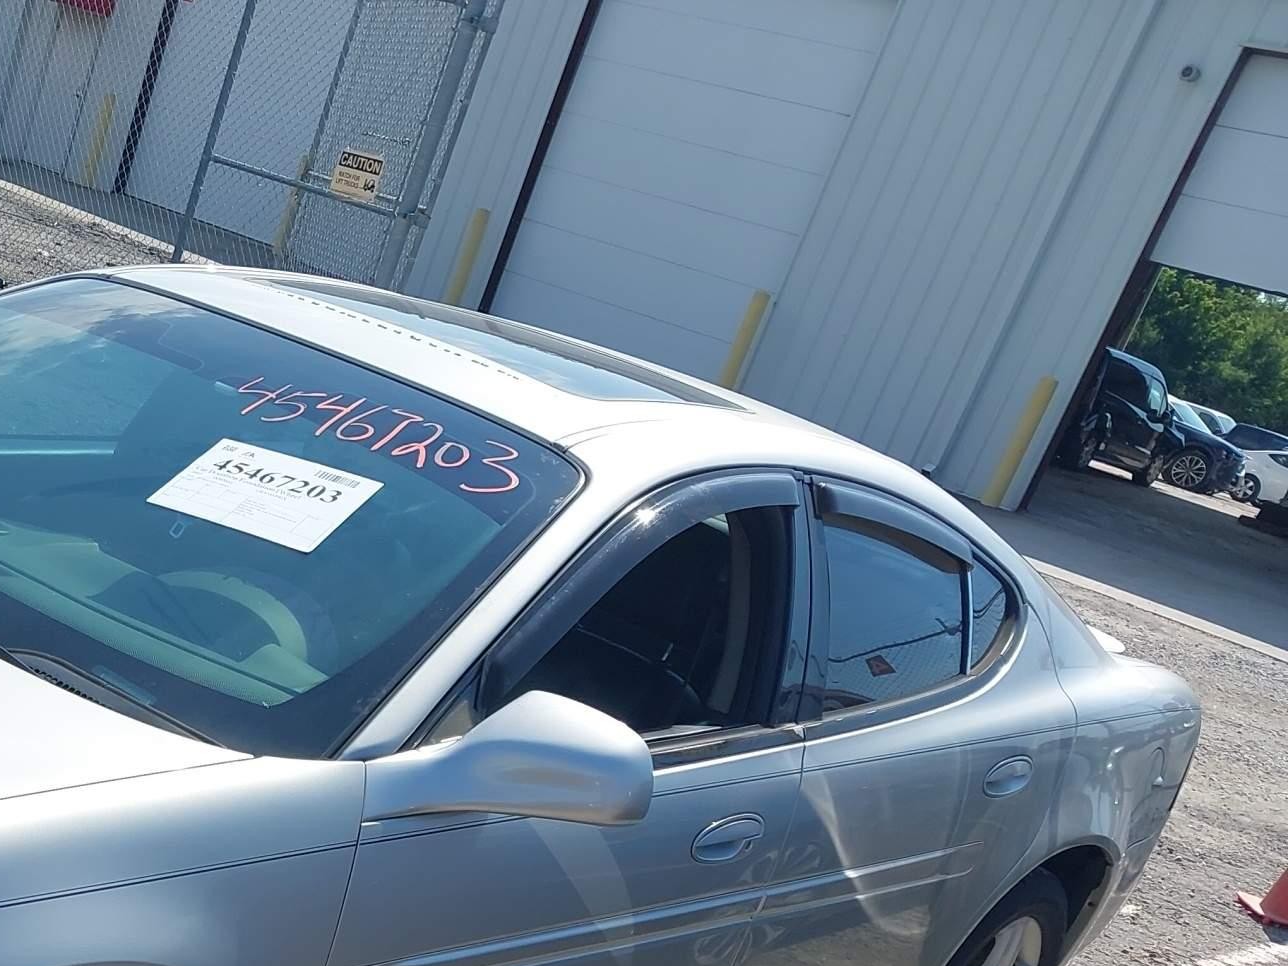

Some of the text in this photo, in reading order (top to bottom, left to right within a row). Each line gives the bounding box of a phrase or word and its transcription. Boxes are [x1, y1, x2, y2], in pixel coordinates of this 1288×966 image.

[341, 153, 382, 174] CAUTION
[238, 377, 520, 493] 45467203
[213, 459, 342, 503] 45467203
